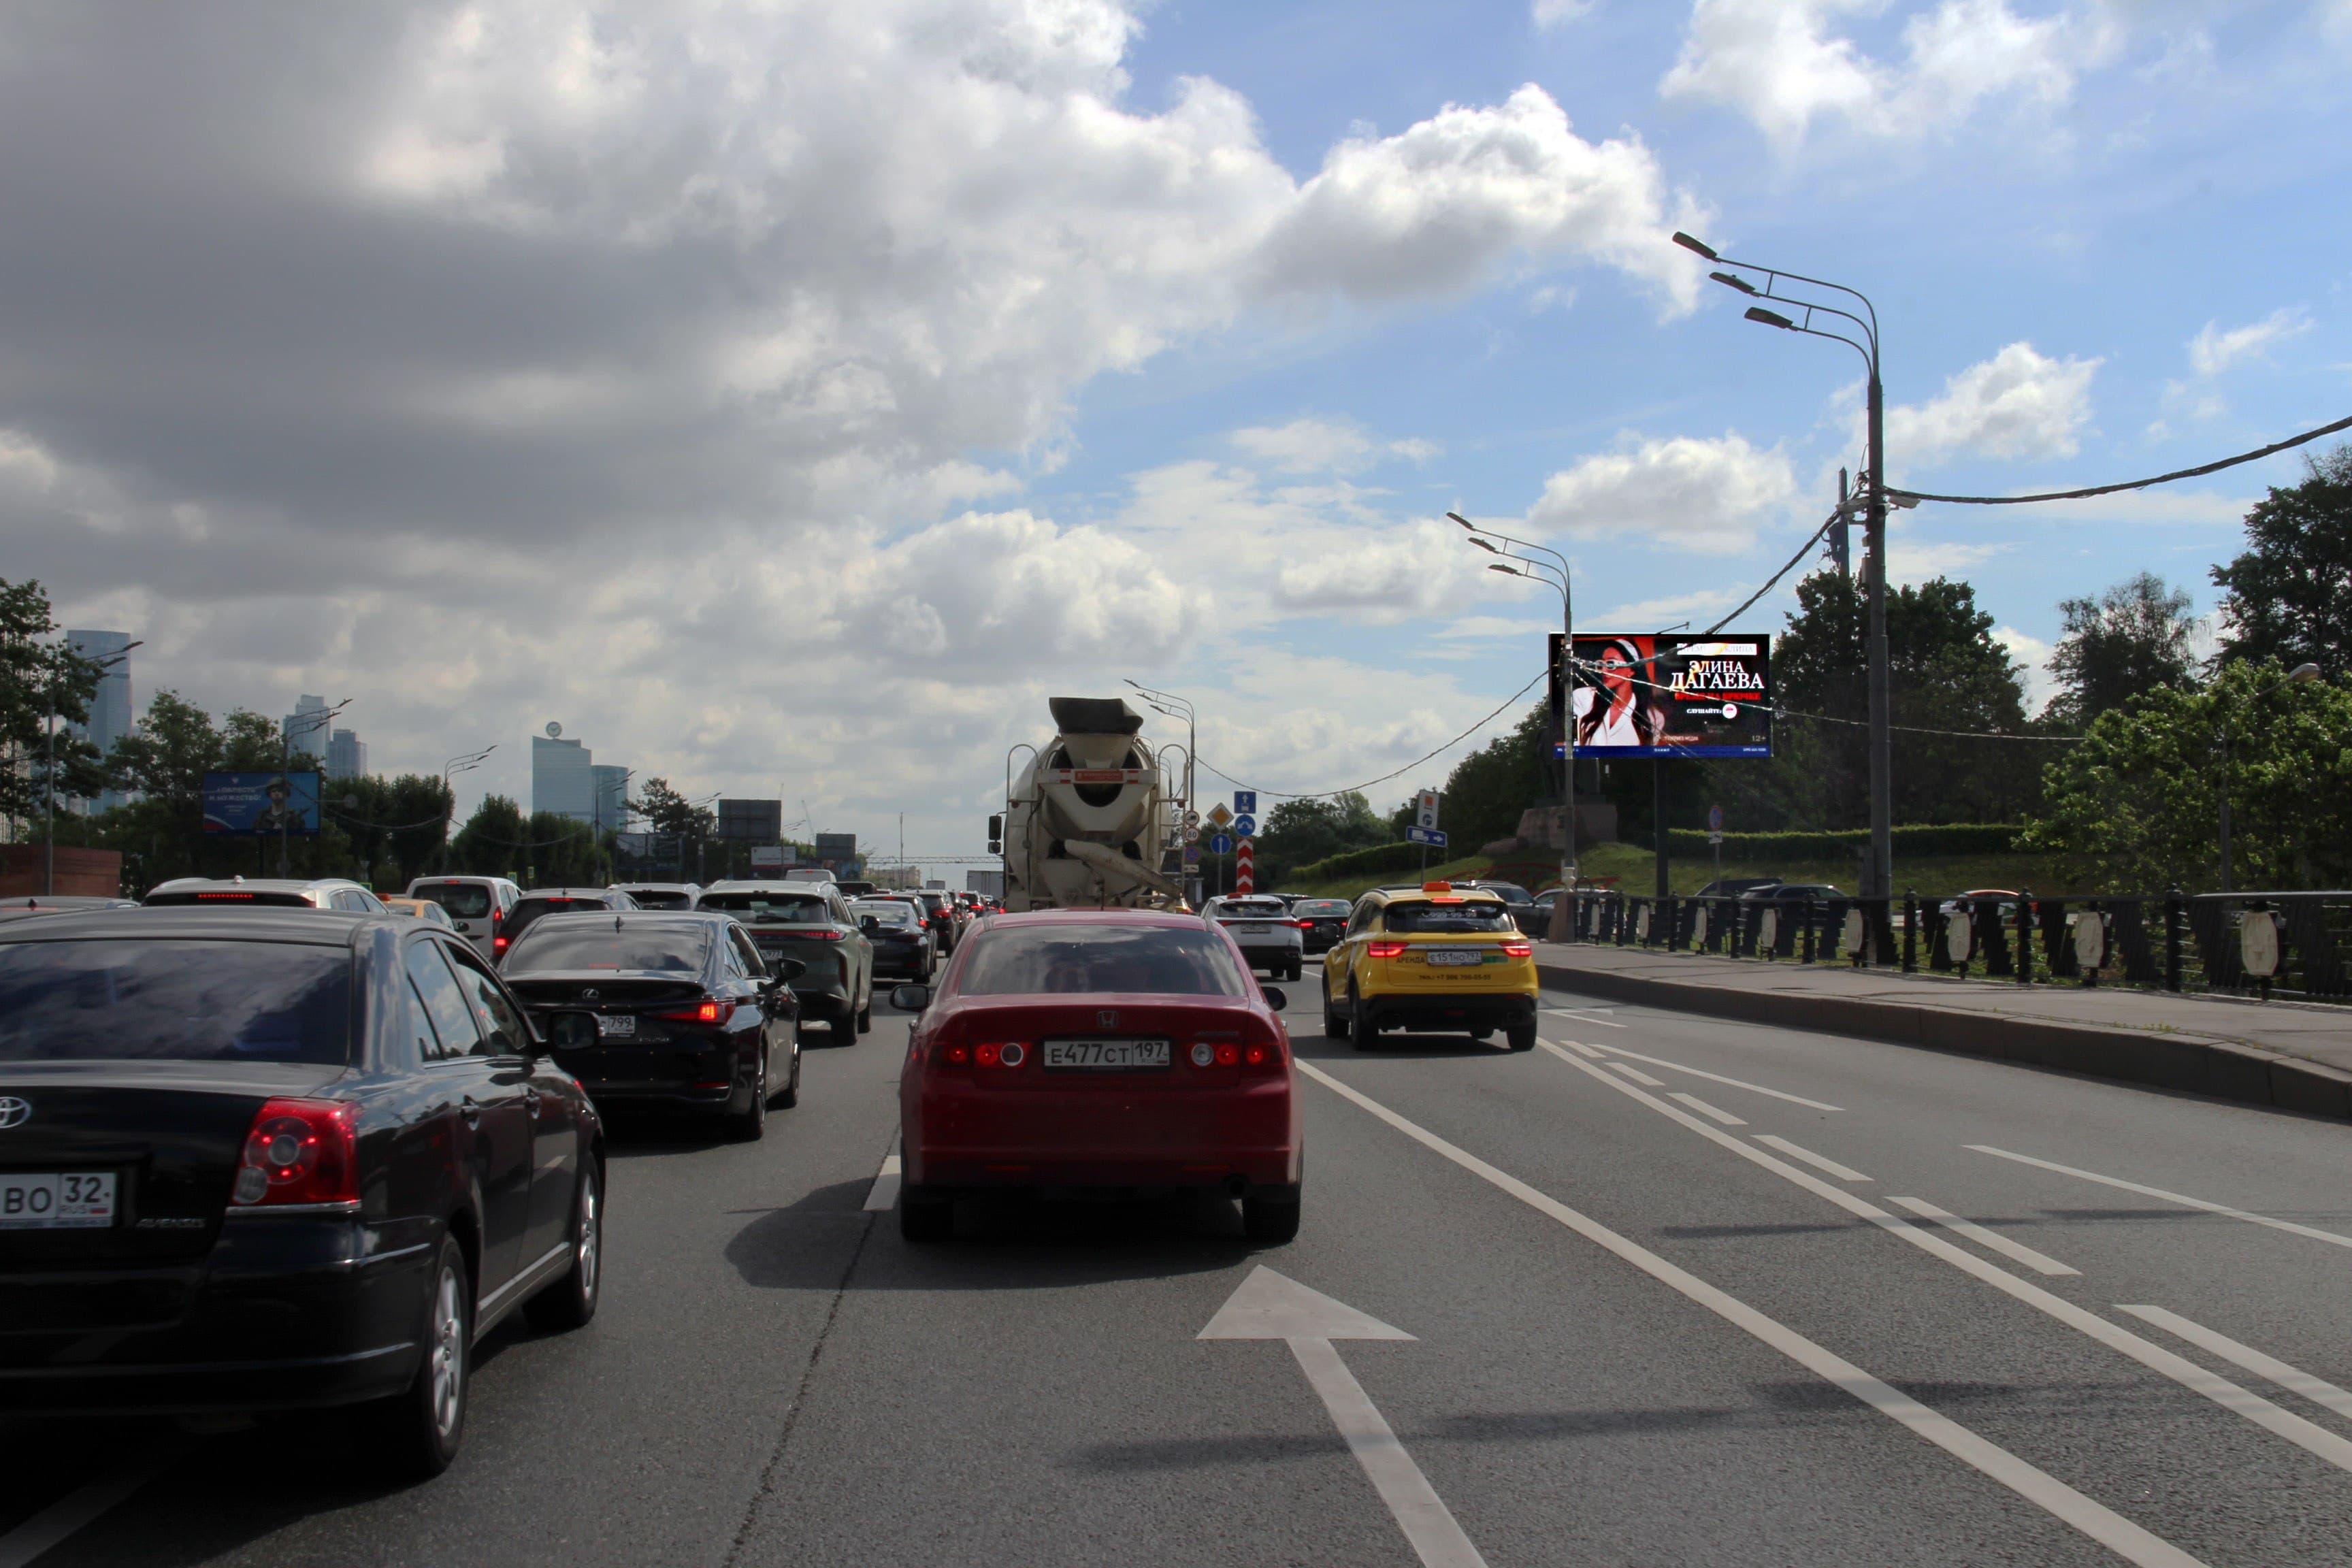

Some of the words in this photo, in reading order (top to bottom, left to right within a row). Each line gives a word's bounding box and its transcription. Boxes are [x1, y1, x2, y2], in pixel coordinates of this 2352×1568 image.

[1689, 660, 1744, 673] ЭЛИНА
[1669, 672, 1765, 691] ДАГАЕВА
[610, 1017, 632, 1028] 799
[1051, 1043, 1129, 1064] Е477СТ
[1134, 1043, 1163, 1058] 197
[65, 1176, 102, 1203] 32
